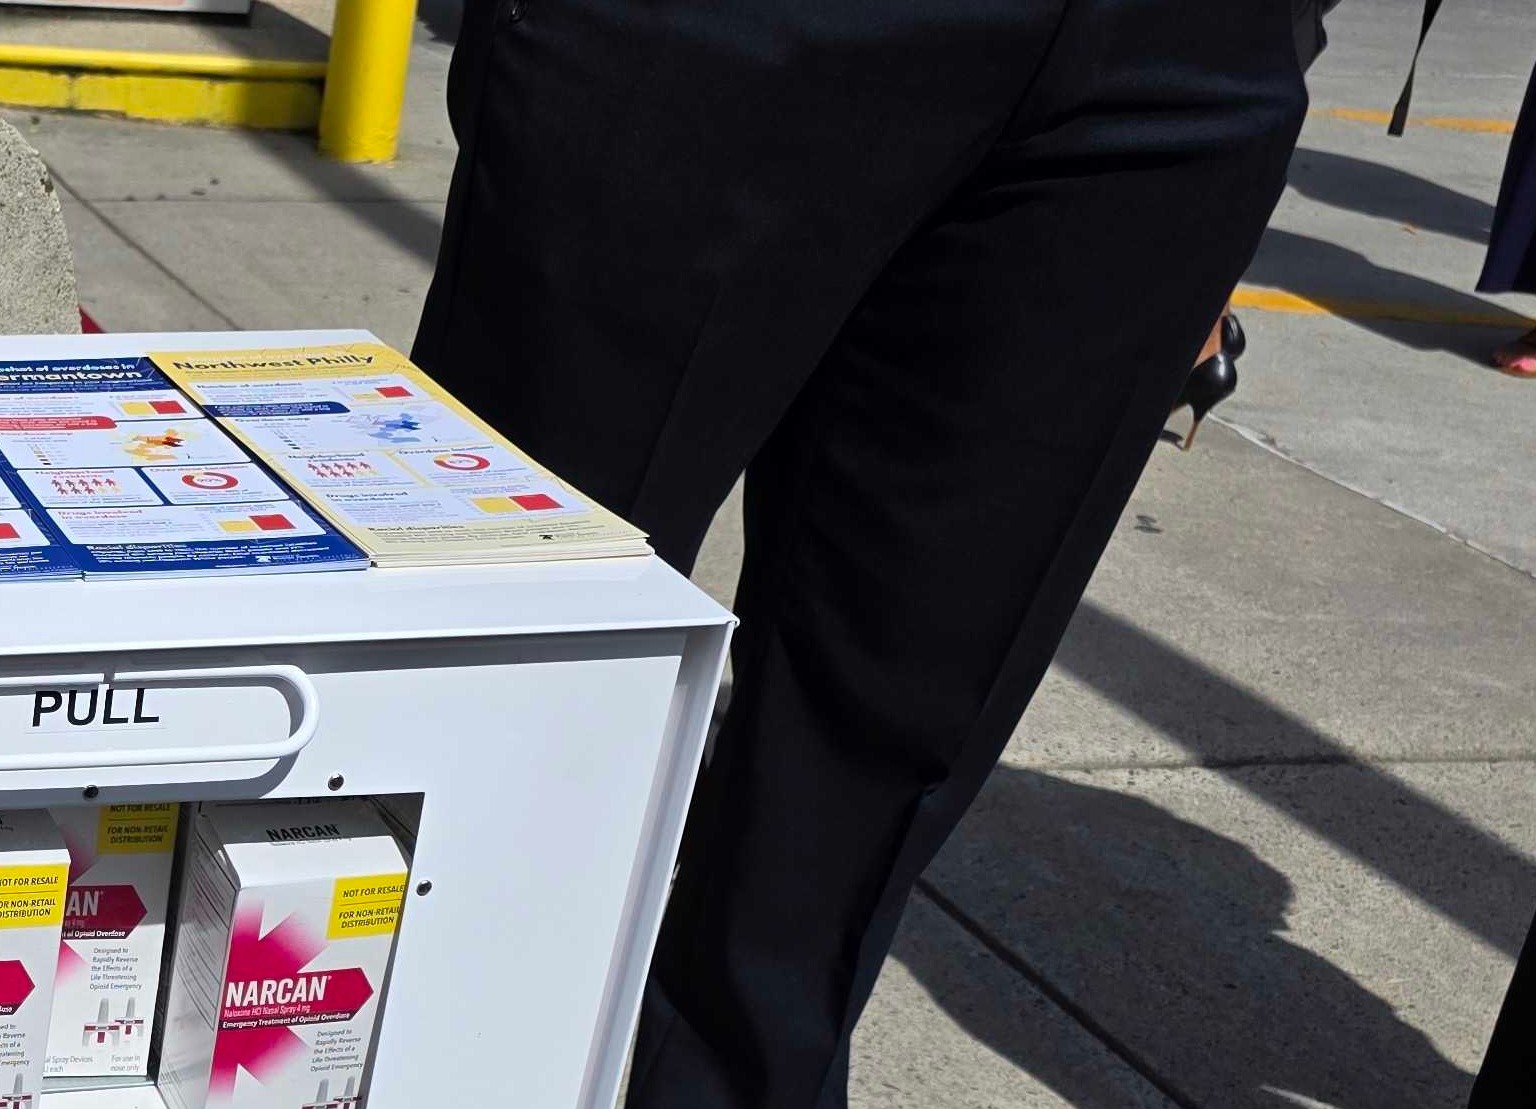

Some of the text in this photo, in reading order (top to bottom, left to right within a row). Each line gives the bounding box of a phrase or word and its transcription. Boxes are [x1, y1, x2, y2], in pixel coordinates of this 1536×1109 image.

[172, 355, 374, 371] Northwest Philly
[32, 688, 160, 727] PULL
[107, 826, 123, 834] FOR
[266, 823, 340, 842] NARCAN
[110, 835, 163, 844] DISTRIBUTION
[14, 878, 30, 886] FOR
[31, 876, 59, 885] RESALE
[343, 885, 404, 898] NOT FOR RESALE
[11, 899, 56, 908] NON-RETAIL
[339, 907, 401, 920] FOR NON-RETAIL
[341, 917, 394, 928] DISTRIBUTION
[226, 976, 327, 1008] NARCAN
[223, 1020, 257, 1029] Emergency
[259, 1018, 290, 1026] Treatment
[299, 1015, 319, 1023] Opioid
[321, 1013, 350, 1021] Overdose
